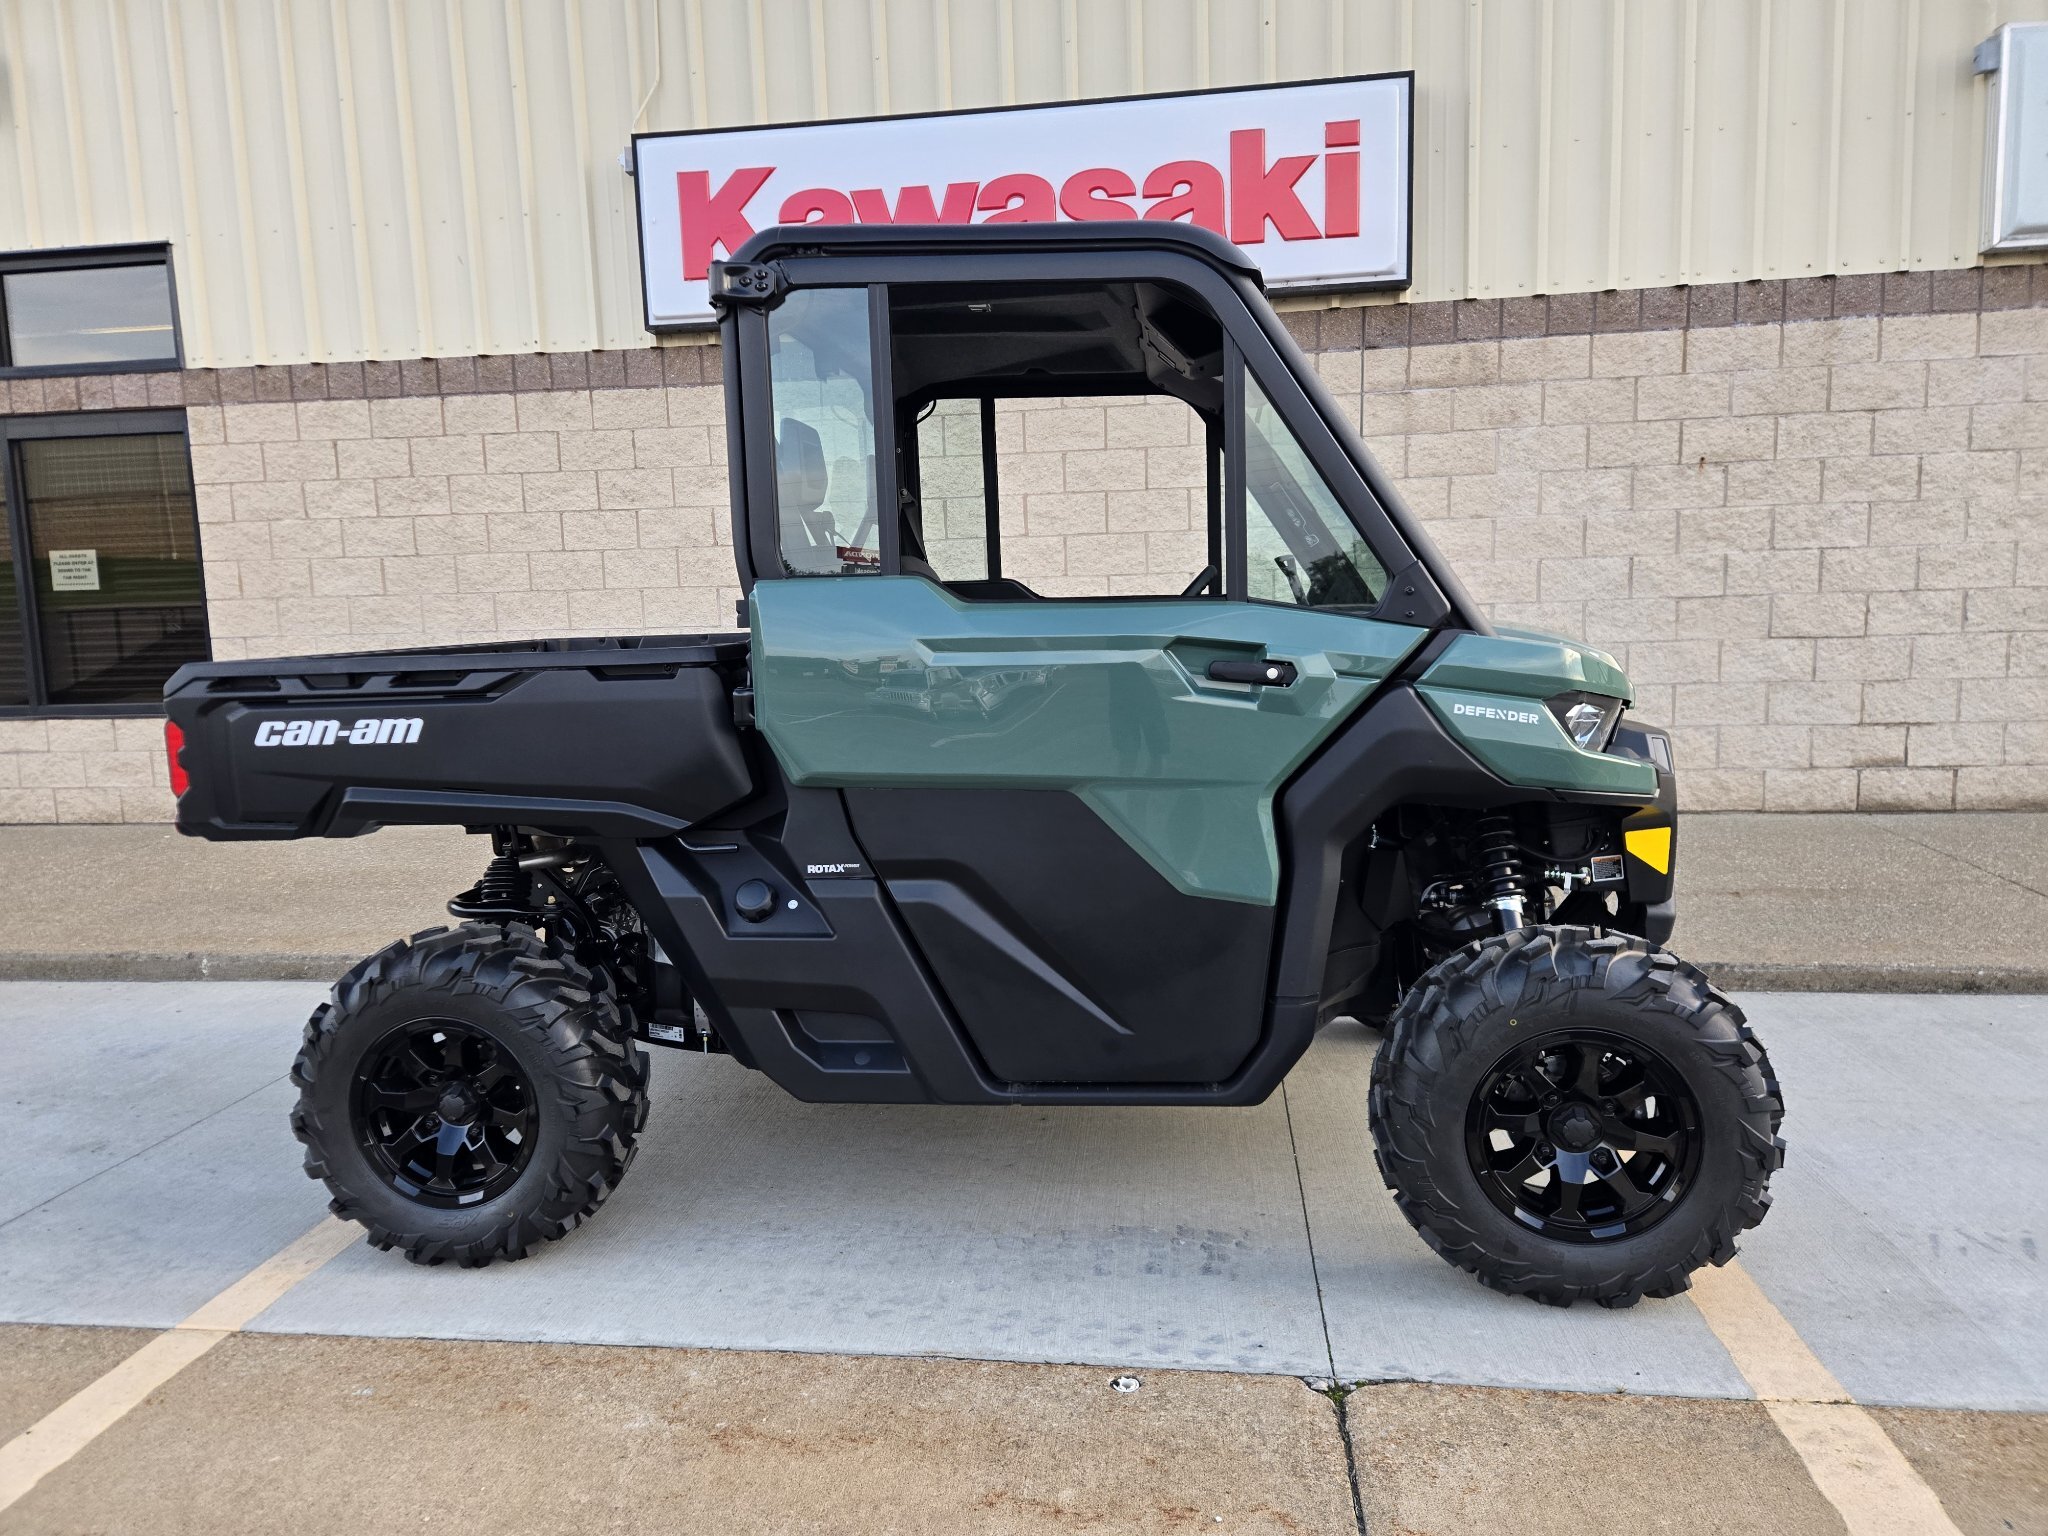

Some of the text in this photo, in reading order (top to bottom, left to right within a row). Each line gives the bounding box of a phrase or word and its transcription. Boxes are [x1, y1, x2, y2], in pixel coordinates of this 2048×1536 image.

[1453, 703, 1539, 725] DEFENDER
[254, 717, 424, 747] can-am
[807, 864, 844, 874] ROTAX
